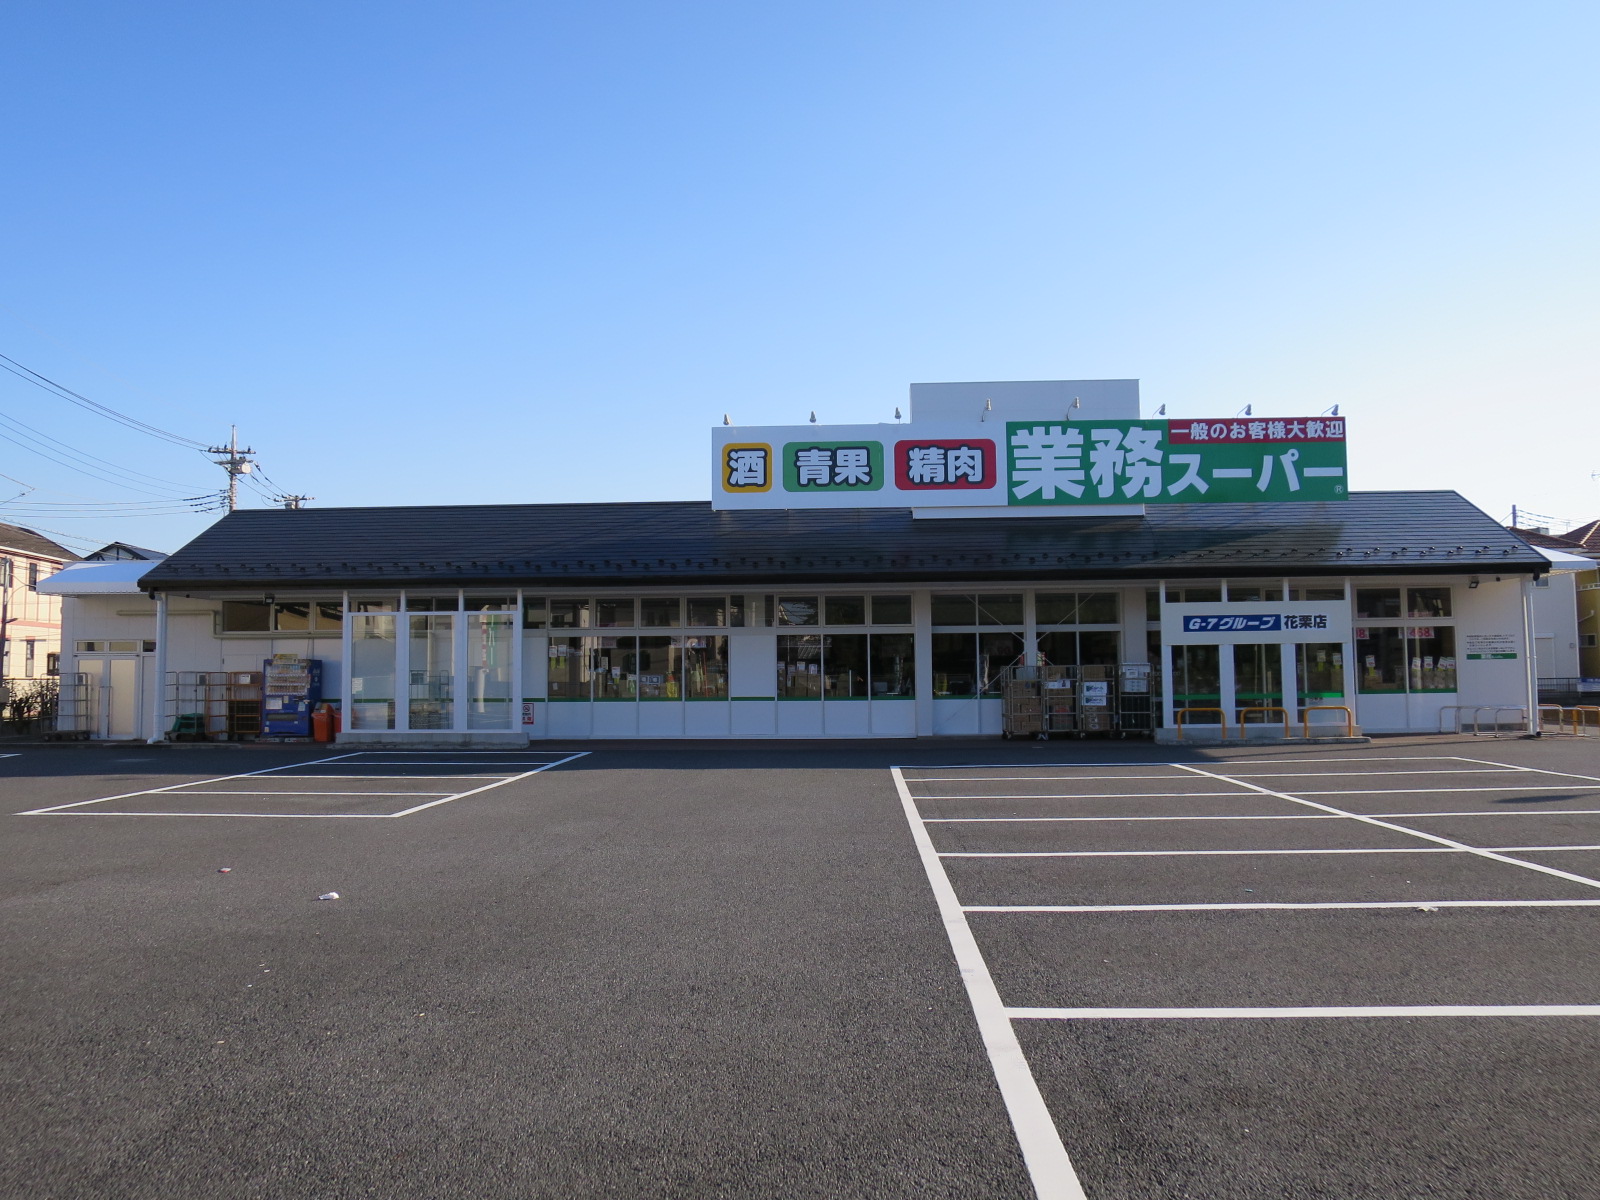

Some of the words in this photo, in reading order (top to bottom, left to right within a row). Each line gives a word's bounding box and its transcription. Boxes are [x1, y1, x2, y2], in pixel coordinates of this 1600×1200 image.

[1170, 420, 1344, 440] 一般のお客様大歓迎
[728, 449, 767, 487] 酒
[795, 447, 873, 488] 青果
[907, 445, 985, 484] 精肉
[1010, 425, 1344, 500] 業務スーパー
[1188, 616, 1276, 630] G-7グループ
[1284, 614, 1327, 629] 花栗店
